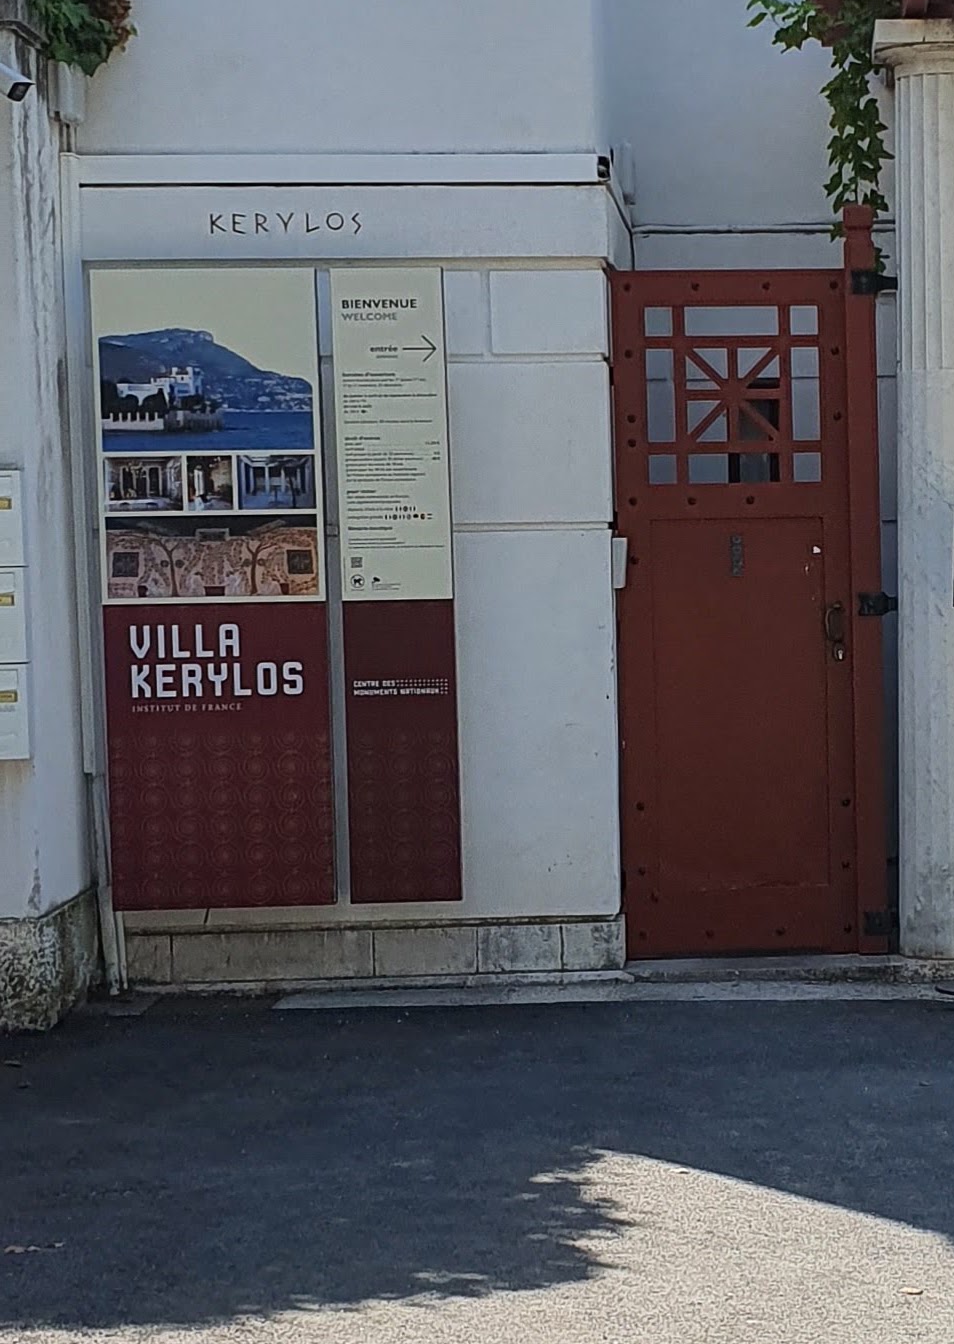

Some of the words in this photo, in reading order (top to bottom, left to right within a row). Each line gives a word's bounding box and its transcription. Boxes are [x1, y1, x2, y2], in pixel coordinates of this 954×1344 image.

[209, 212, 362, 235] KERYLOS
[341, 299, 417, 309] BIENVENUE
[341, 312, 398, 321] WELCOME
[370, 344, 398, 353] entrée
[129, 623, 240, 659] VILLA
[130, 661, 304, 698] KERYLOS
[353, 680, 379, 688] CENTRE
[382, 679, 396, 687] DES
[132, 704, 181, 713] INSTITUT
[184, 703, 197, 712] DE
[201, 702, 242, 712] FRANCE
